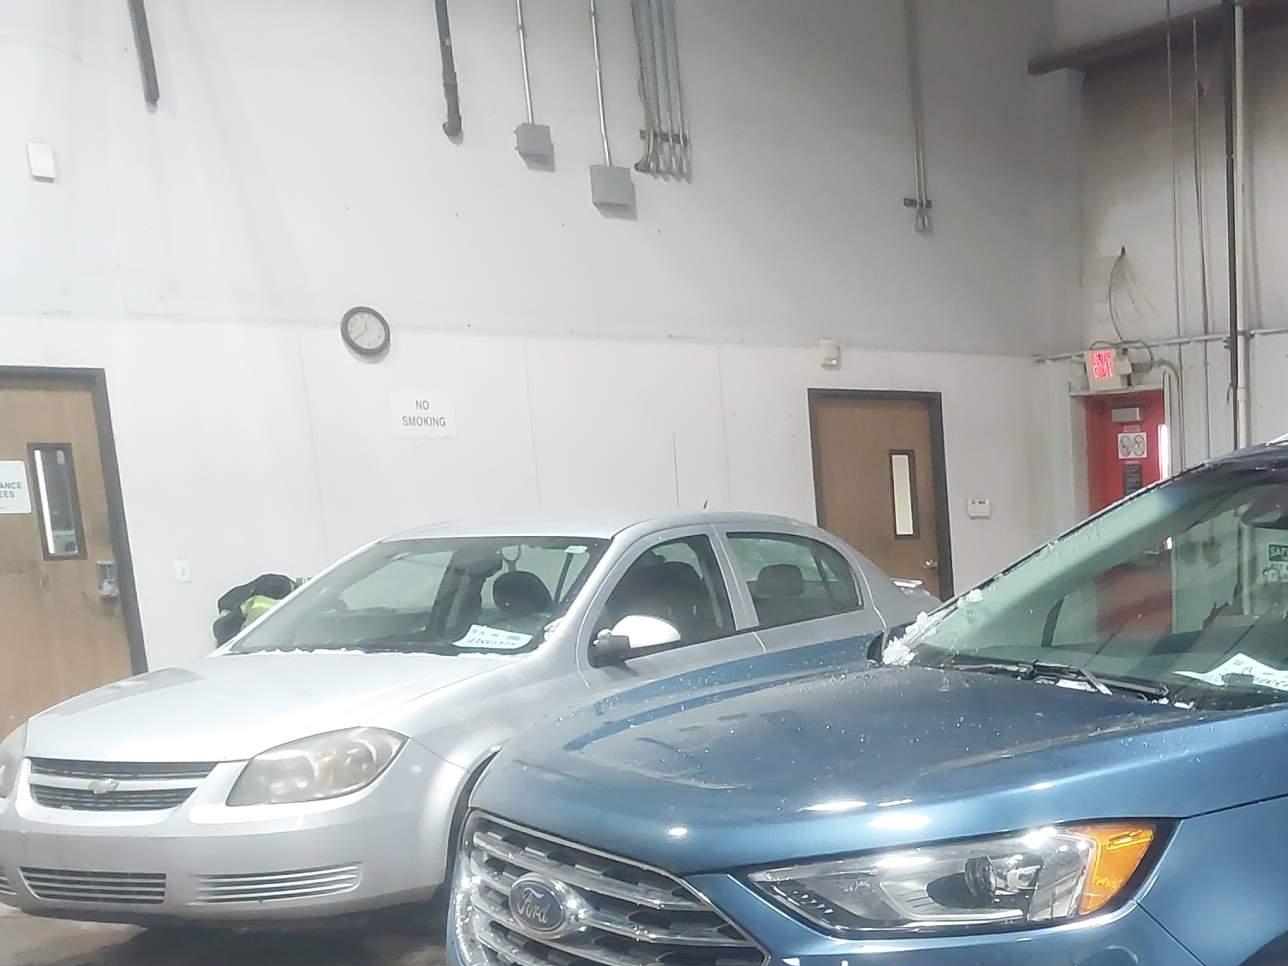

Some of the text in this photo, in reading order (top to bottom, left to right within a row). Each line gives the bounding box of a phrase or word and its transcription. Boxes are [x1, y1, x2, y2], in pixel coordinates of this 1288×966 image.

[415, 399, 430, 411] NO
[401, 415, 447, 427] SMOKING
[516, 886, 553, 924] Ford
